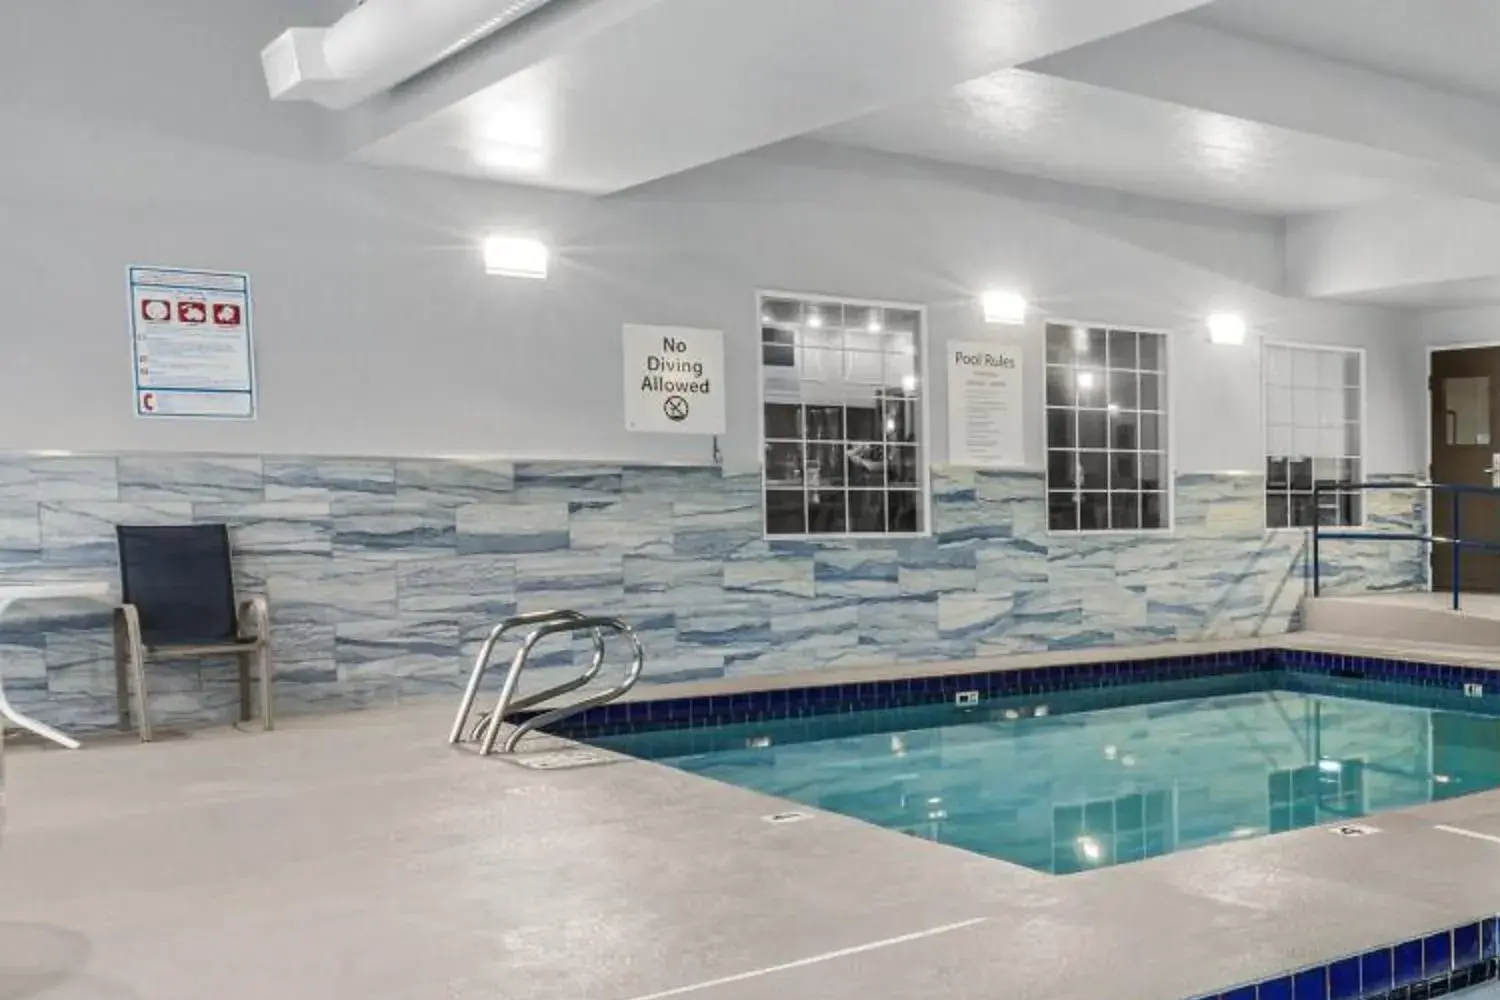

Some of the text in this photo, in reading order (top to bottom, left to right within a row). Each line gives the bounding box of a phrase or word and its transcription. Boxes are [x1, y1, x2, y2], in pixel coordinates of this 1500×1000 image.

[663, 336, 687, 353] No
[646, 355, 704, 378] Diving
[955, 351, 1016, 369] Pool Rules
[641, 375, 710, 394] Allowed
